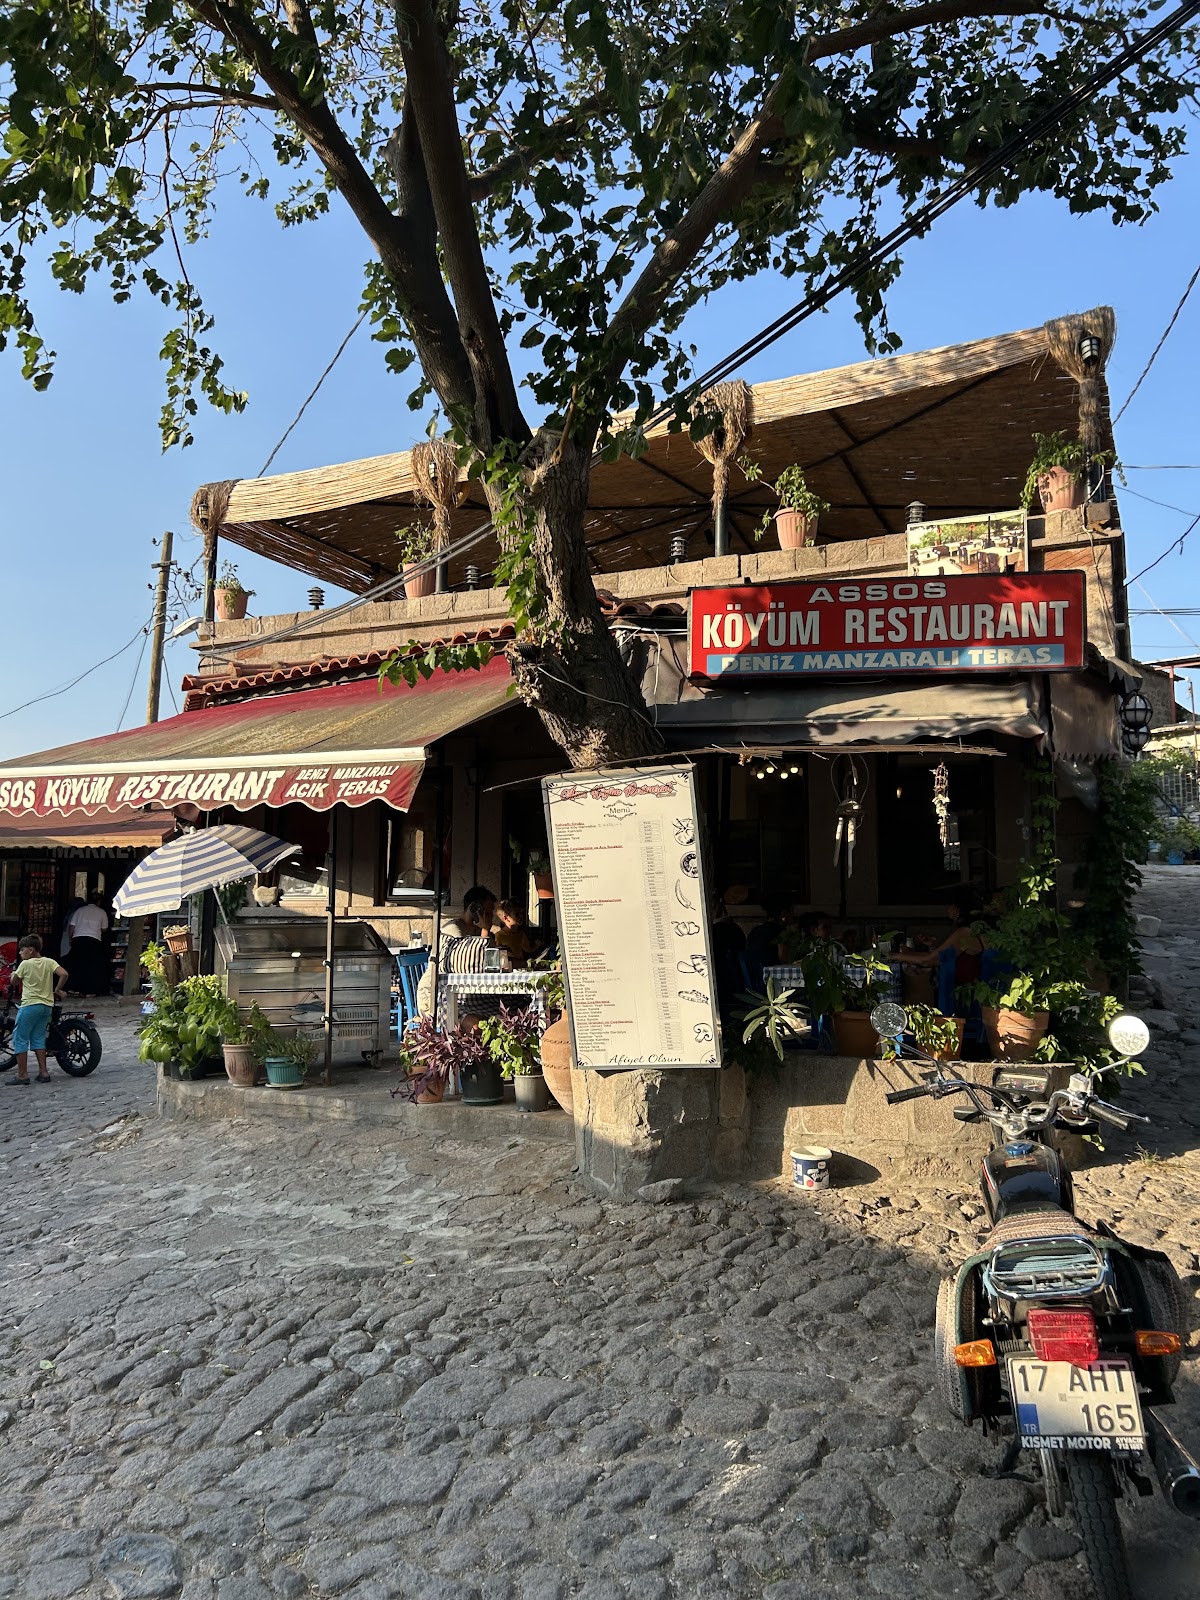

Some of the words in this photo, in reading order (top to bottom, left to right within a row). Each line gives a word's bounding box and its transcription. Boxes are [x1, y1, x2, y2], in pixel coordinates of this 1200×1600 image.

[808, 582, 948, 604] ASSOS
[702, 602, 821, 649] KÖYÜM
[844, 600, 1070, 645] RESTAURANT
[803, 648, 959, 670] MANZARALI
[967, 646, 1053, 666] TERAS
[333, 765, 400, 780] MANZARALI
[116, 769, 287, 802] RESTAURANT
[336, 779, 391, 798] TERAS
[608, 1054, 645, 1066] Afiyet
[647, 1053, 683, 1064] Olsun
[1018, 1365, 1048, 1392] 17
[1069, 1364, 1127, 1392] AHT
[1023, 1423, 1037, 1433] TR
[1081, 1403, 1137, 1433] 165
[1021, 1435, 1064, 1449] KISMET
[1067, 1436, 1112, 1450] MOTOR
